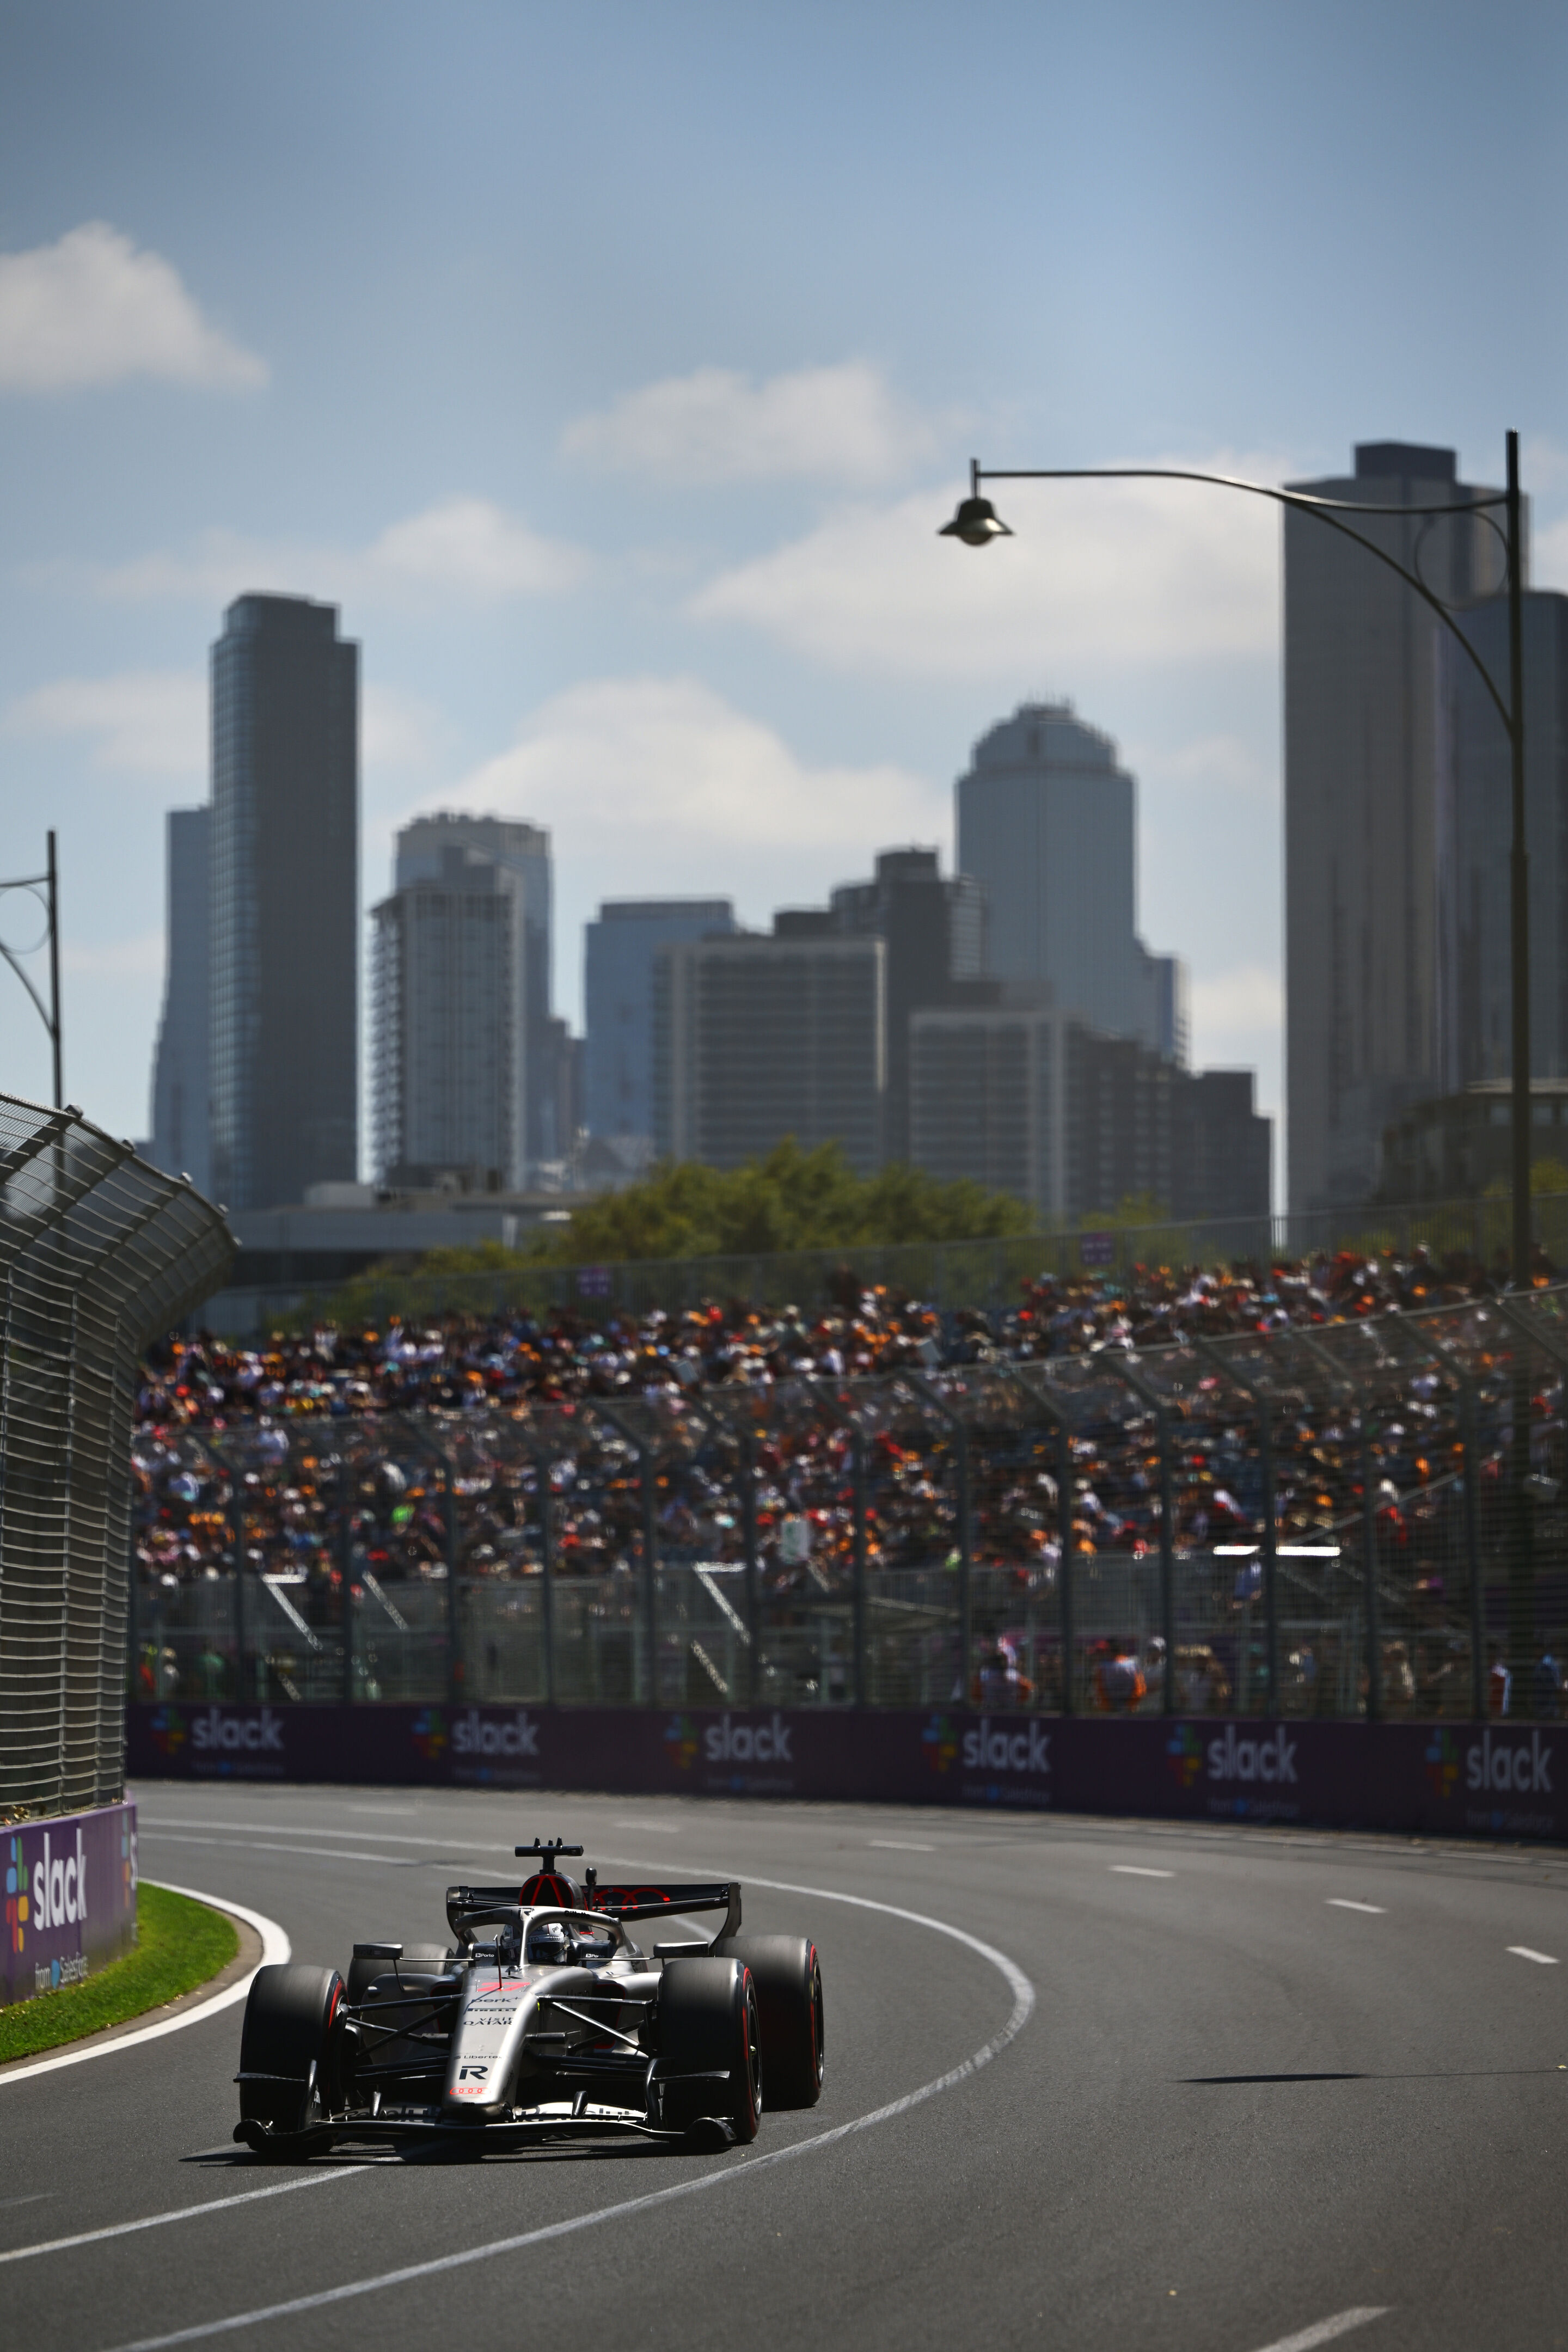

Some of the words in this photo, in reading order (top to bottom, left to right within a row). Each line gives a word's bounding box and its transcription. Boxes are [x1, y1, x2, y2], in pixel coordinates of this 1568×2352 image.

[192, 1706, 285, 1750] slack
[452, 1709, 540, 1755] slack
[705, 1712, 793, 1762] slack
[962, 1716, 1051, 1773] slack
[1208, 1723, 1298, 1783] slack
[1467, 1728, 1553, 1793] slack
[34, 1828, 87, 1931] slack
